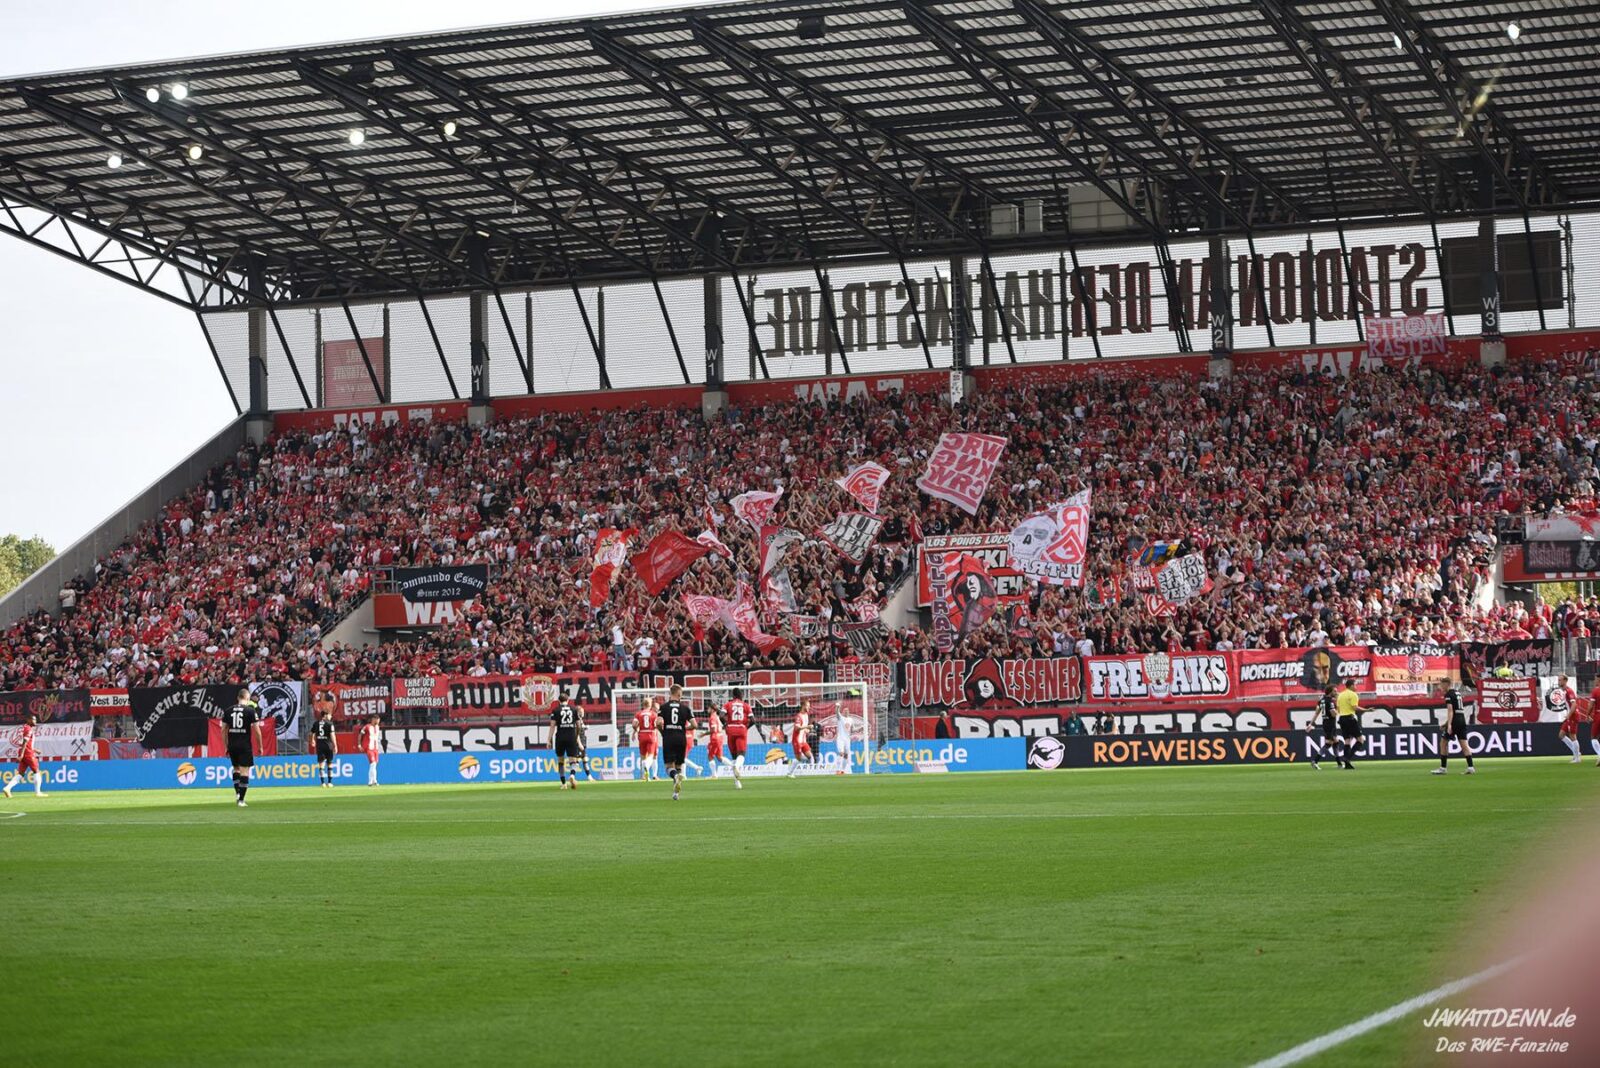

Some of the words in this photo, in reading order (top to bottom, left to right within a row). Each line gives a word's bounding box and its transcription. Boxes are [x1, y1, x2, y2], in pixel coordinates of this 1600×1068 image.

[1482, 297, 1497, 311] W
[1485, 312, 1495, 327] 3
[1367, 336, 1443, 358] KASTEN
[454, 572, 484, 589] Essen
[441, 587, 461, 597] 2012
[1240, 662, 1305, 681] NORTHSIDE
[1336, 661, 1370, 677] CREW
[1481, 661, 1551, 679] ESEN
[901, 660, 966, 707] JUNGE
[1003, 655, 1082, 703] ESSENER
[450, 680, 522, 710] RUDE
[556, 676, 639, 705] FANS
[344, 700, 386, 715] ESSEN
[671, 708, 679, 724] 6
[230, 711, 244, 728] 16
[560, 710, 573, 725] 23
[319, 724, 324, 736] 5
[1094, 739, 1226, 763] ROT-WEISS
[1233, 736, 1296, 762] VOR,
[1396, 733, 1438, 755] EIN
